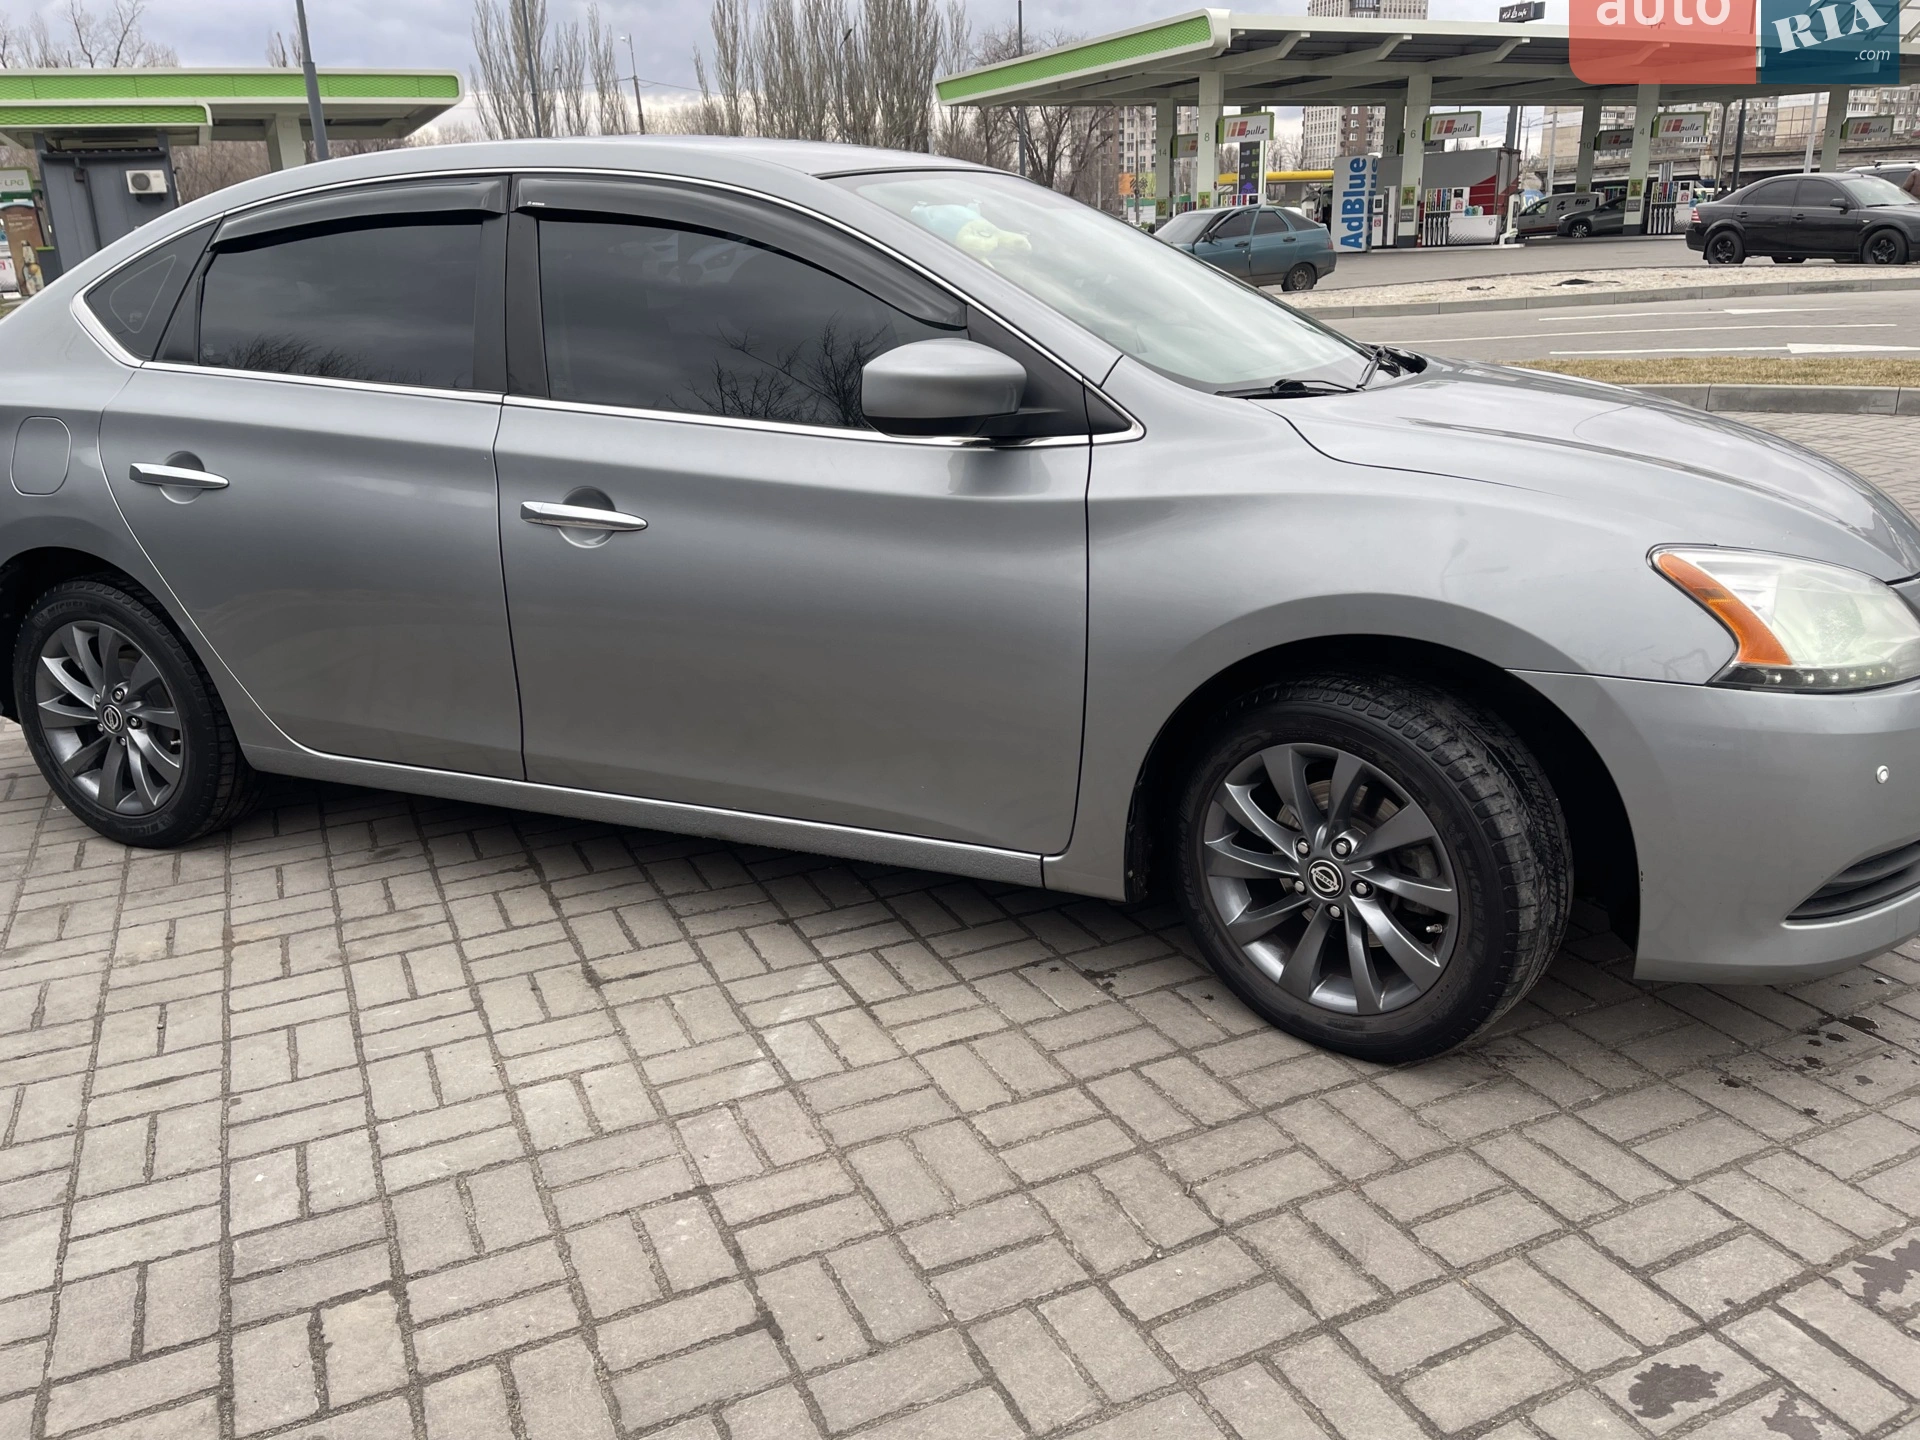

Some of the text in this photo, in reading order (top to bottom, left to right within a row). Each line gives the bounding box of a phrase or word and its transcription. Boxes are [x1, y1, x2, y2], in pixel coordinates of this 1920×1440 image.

[1244, 125, 1267, 138] pulls
[1452, 123, 1474, 135] pulls
[1639, 128, 1645, 136] 4
[1680, 123, 1701, 133] pulls
[1867, 125, 1889, 135] pulls
[1204, 132, 1210, 142] 8
[1410, 129, 1417, 139] 6
[1829, 129, 1836, 138] 2
[1386, 145, 1395, 153] 12
[1583, 141, 1591, 149] 10
[4, 178, 24, 187] LPG
[1340, 157, 1367, 249] AdBlue
[1313, 870, 1337, 889] NISSAN
